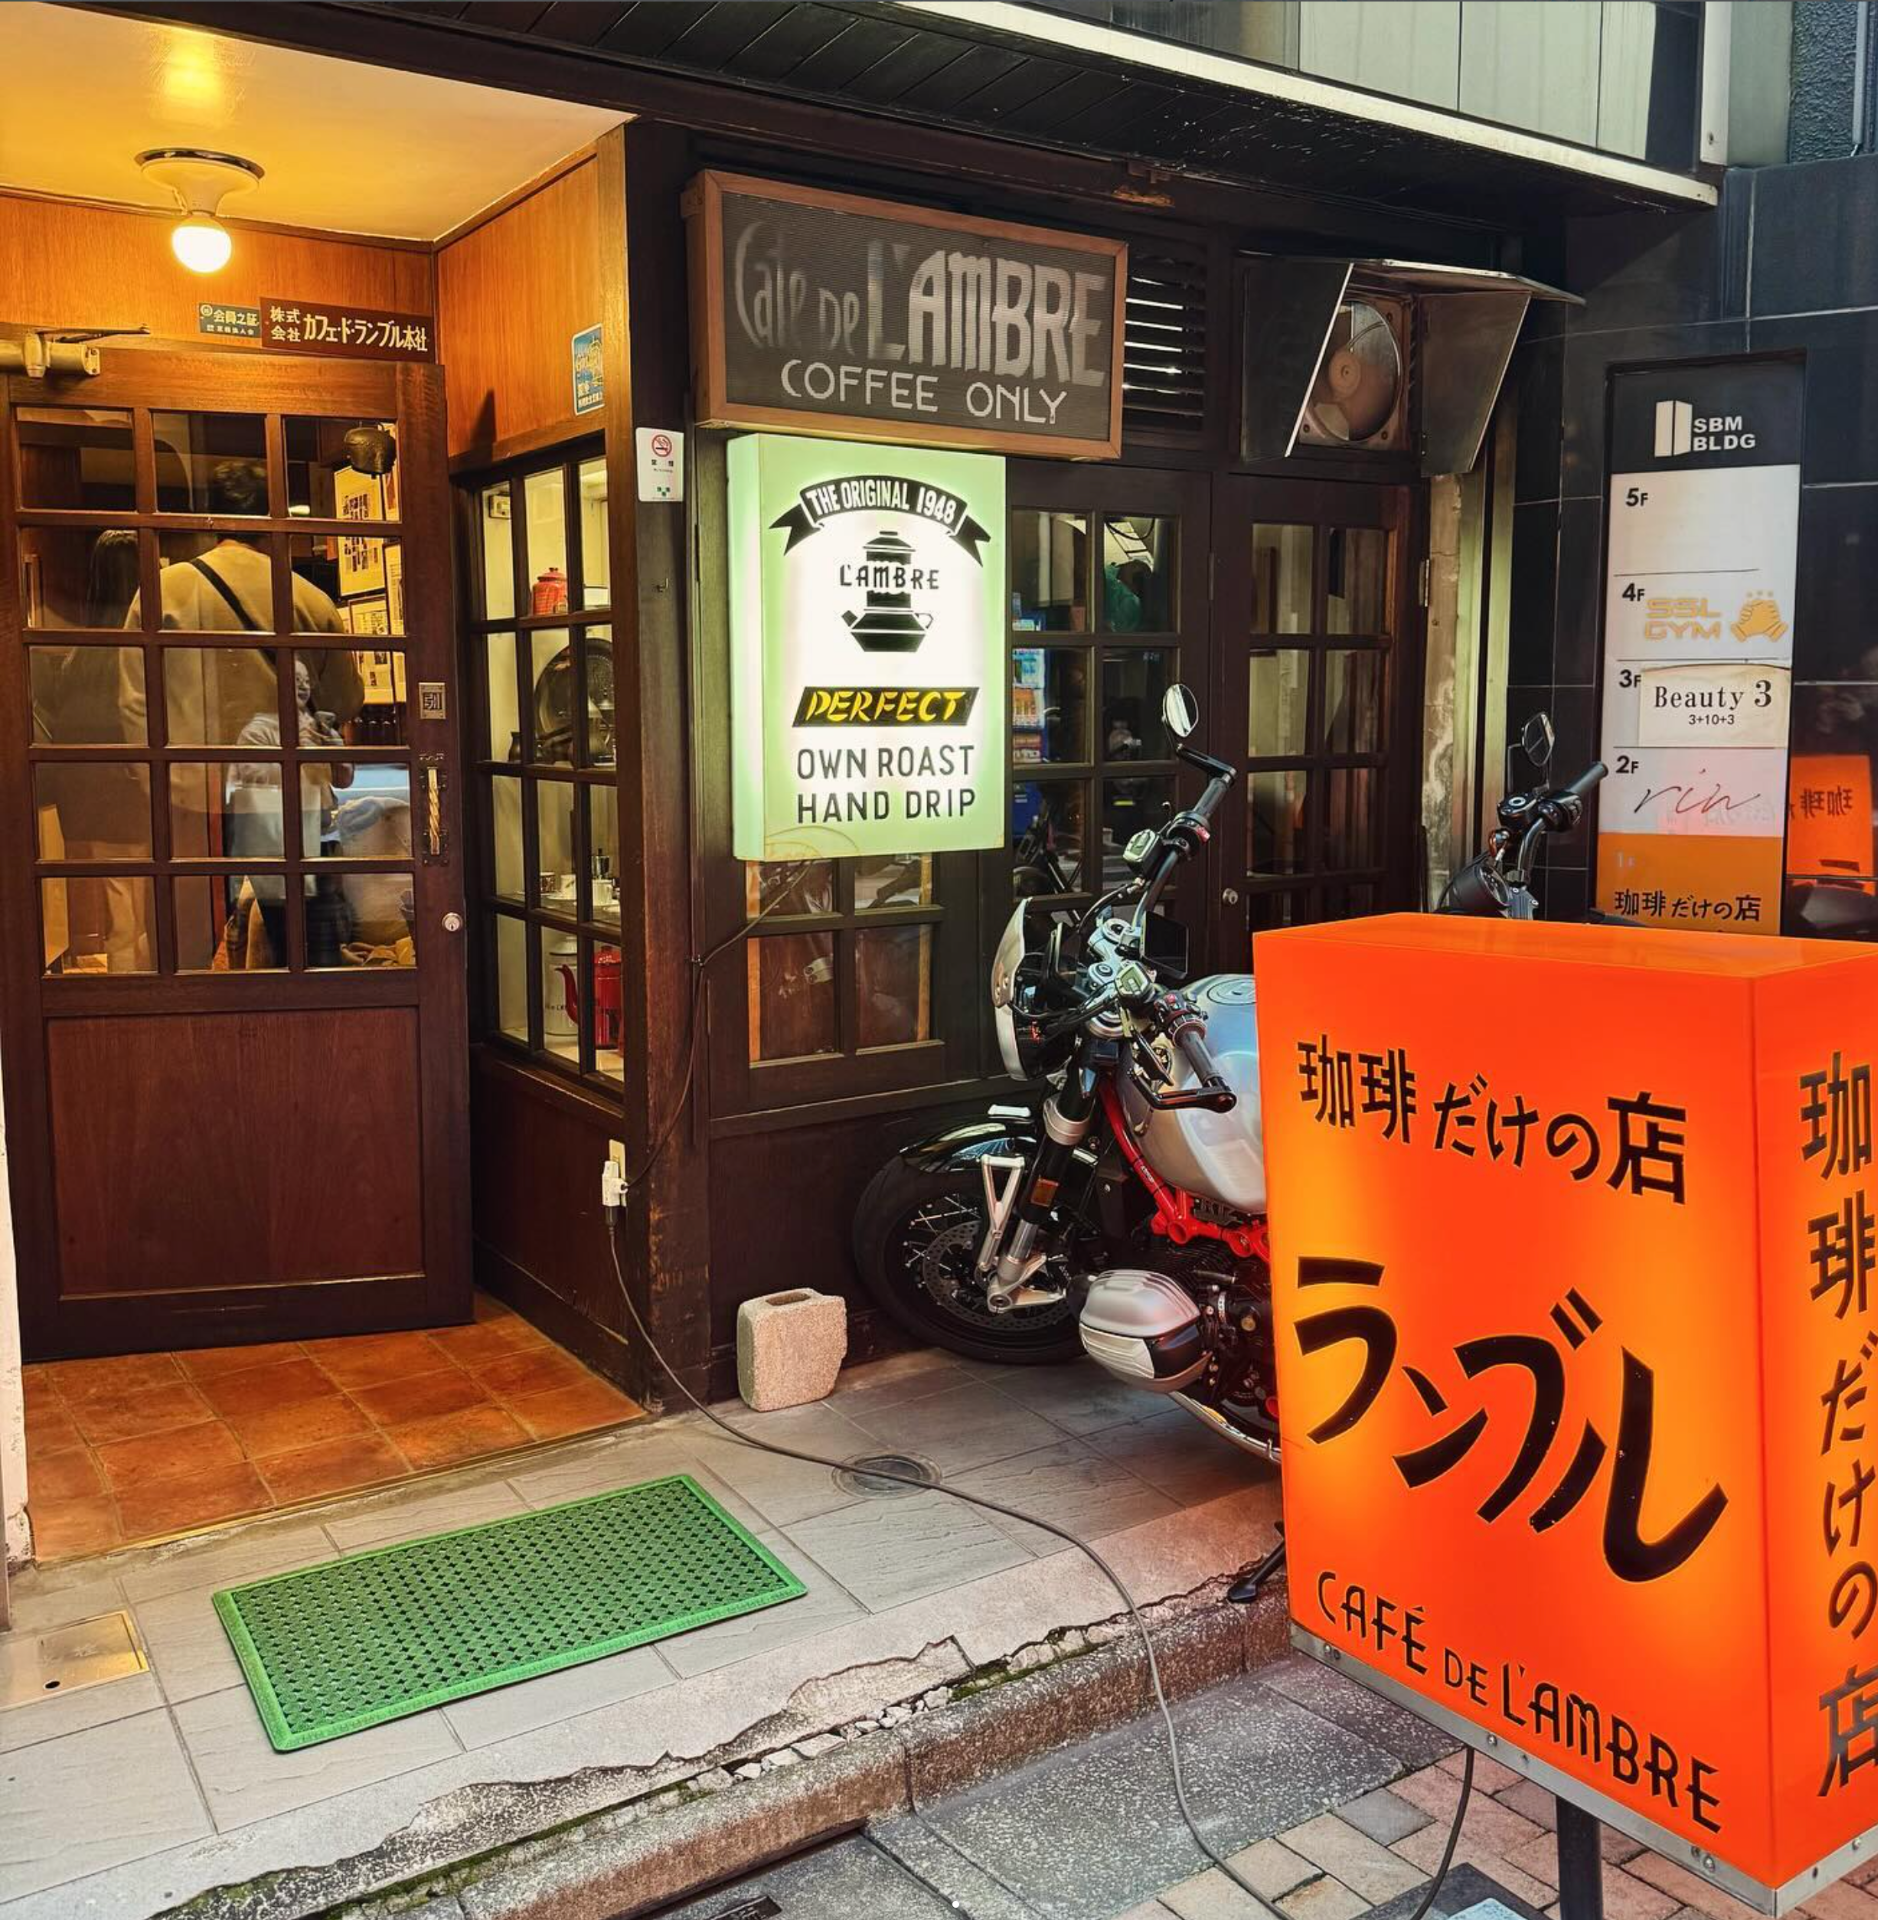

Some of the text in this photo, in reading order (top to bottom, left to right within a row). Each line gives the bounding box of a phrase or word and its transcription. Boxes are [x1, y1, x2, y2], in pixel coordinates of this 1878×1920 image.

[270, 306, 300, 324] 株式
[271, 325, 301, 343] 会社
[781, 359, 1068, 425] COFFEE ONLY
[1693, 416, 1743, 433] SBM
[1692, 434, 1756, 451] BLDG
[805, 479, 957, 525] THE ORIGINAL 1948
[1625, 488, 1649, 507] 5F
[839, 564, 940, 590] L'AMBRE
[1622, 583, 1645, 602] 4F
[1644, 620, 1723, 640] GYM
[1619, 669, 1641, 688] 3F
[805, 690, 967, 722] PERFECT
[1655, 680, 1773, 711] Beauty 3
[1688, 714, 1735, 726] 3+10+3
[797, 748, 867, 780] OWN
[879, 745, 975, 777] ROAST
[1616, 756, 1639, 774] 2F
[798, 791, 890, 824] HAND
[906, 788, 976, 819] DRIP
[1634, 768, 1761, 814] rin
[1614, 889, 1762, 922] 珈琲だけの店
[1298, 1034, 1687, 1206] 珈琲だけの店
[1293, 1256, 1729, 1583] ランブル
[1800, 1051, 1878, 1797] 珈琲だけの店
[1317, 1571, 1721, 1834] CAFÉ DE L'AMBRE
